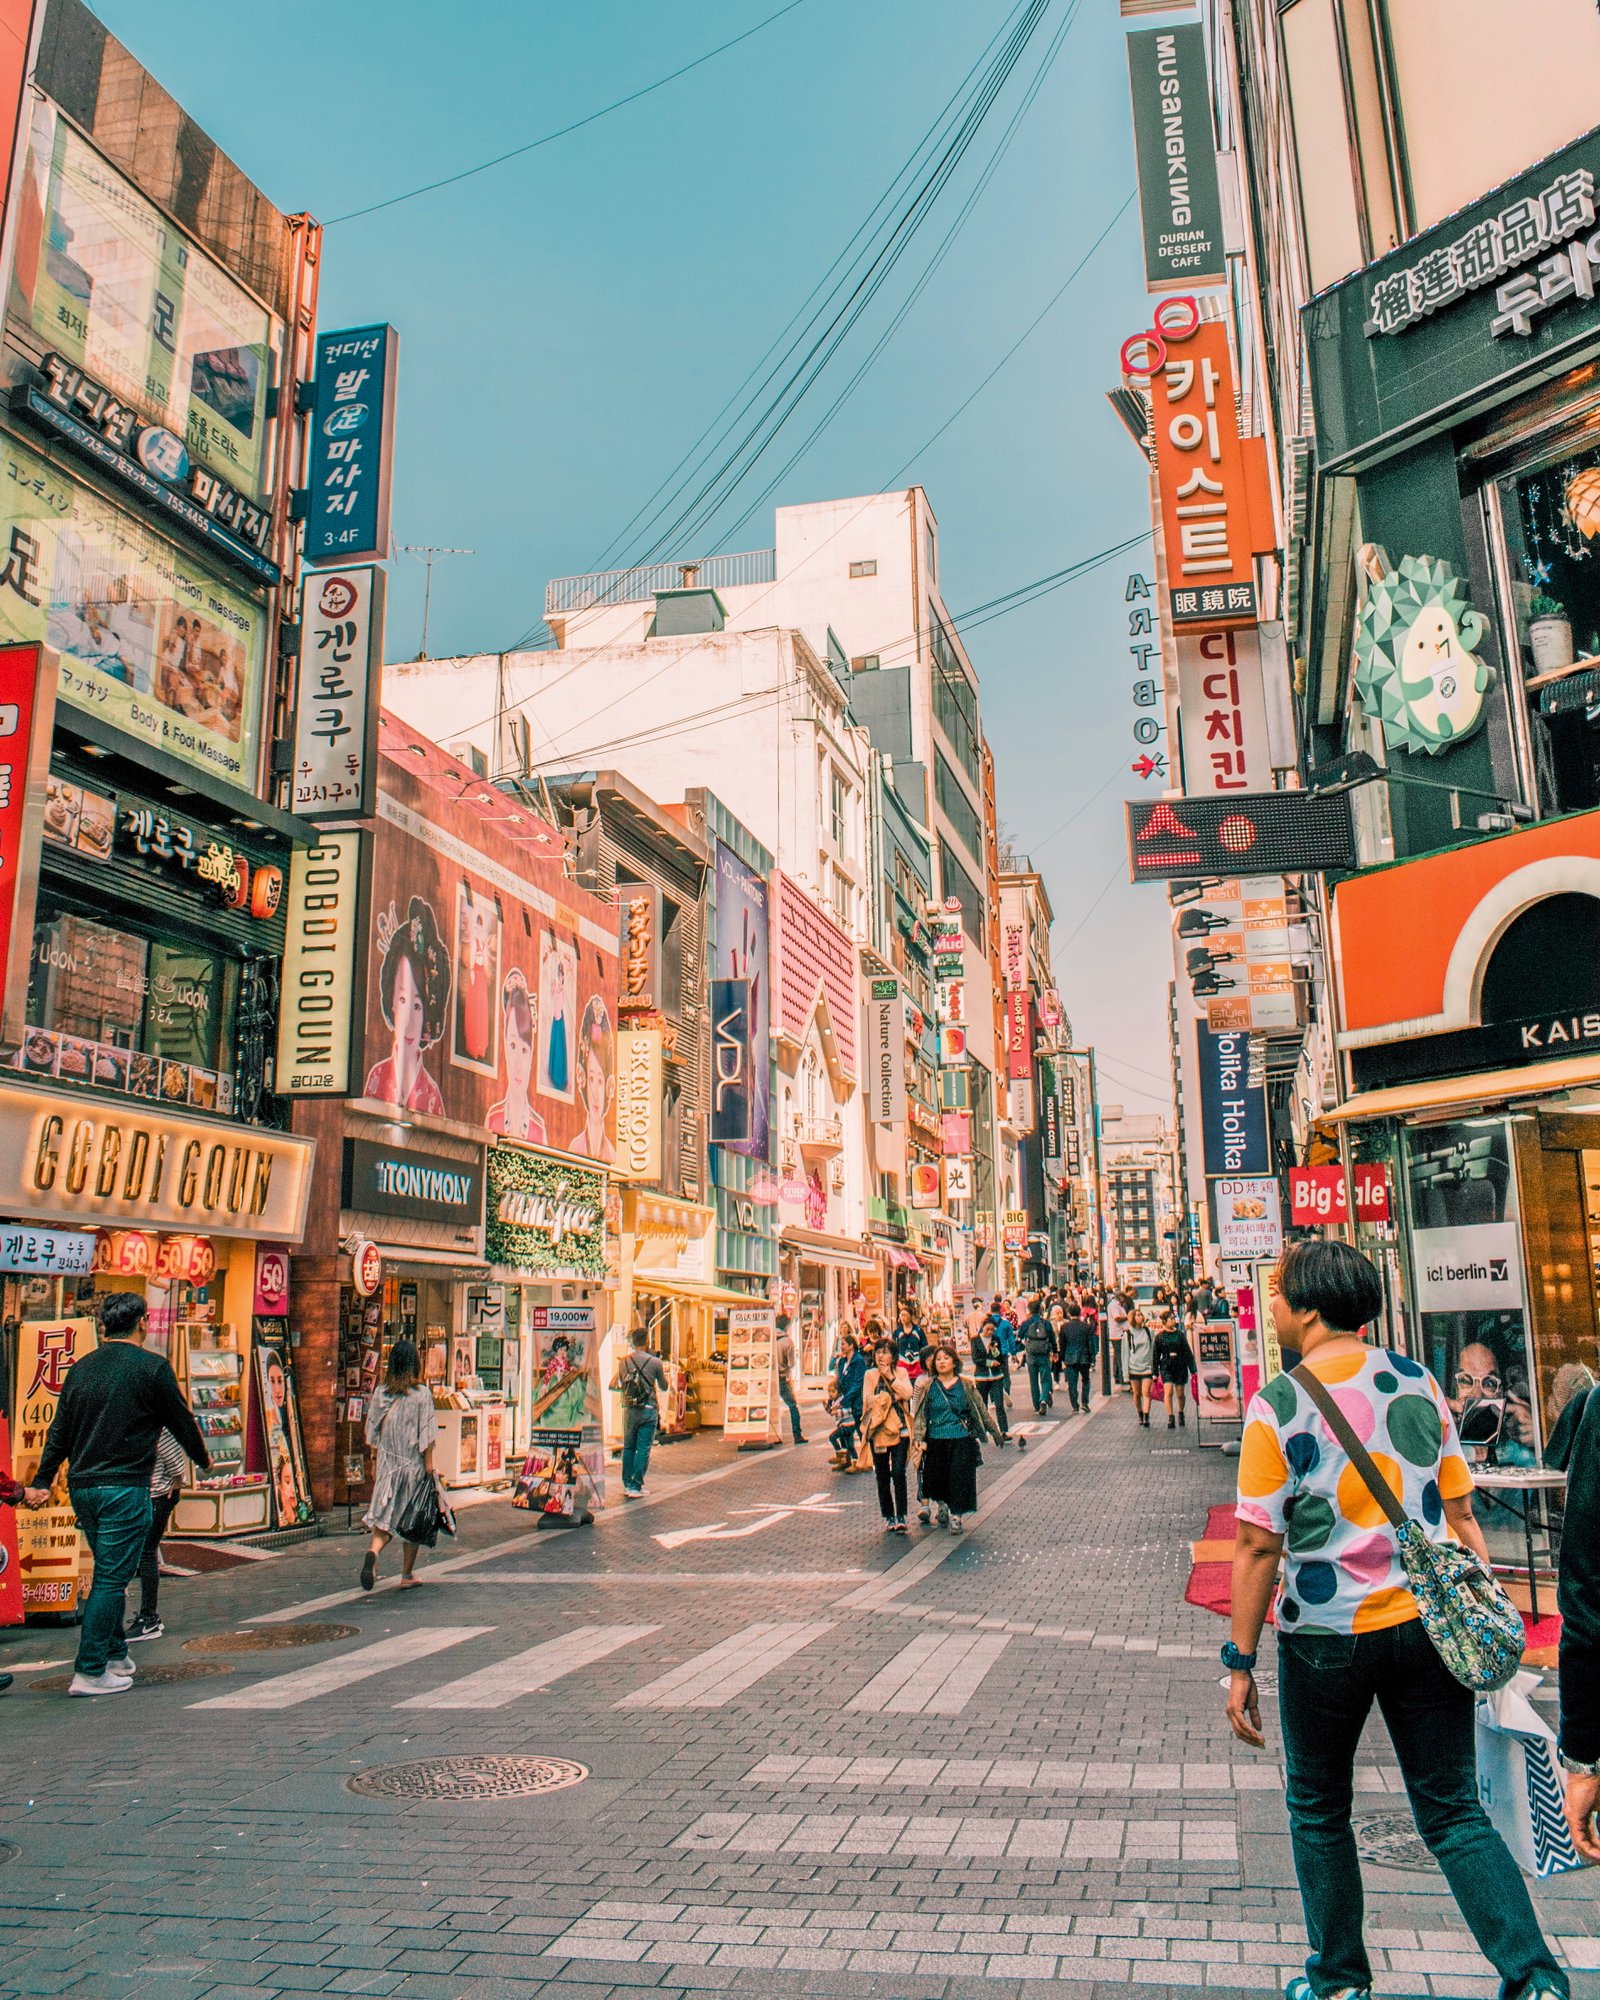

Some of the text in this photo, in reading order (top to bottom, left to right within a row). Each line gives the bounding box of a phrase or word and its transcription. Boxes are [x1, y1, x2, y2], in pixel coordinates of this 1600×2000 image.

[1158, 241, 1211, 257] DESSERT
[1160, 230, 1204, 245] DURIAN
[1171, 255, 1201, 268] CAFE
[325, 337, 379, 364] 컨디션
[47, 355, 137, 448] 컨디션
[192, 469, 272, 549] 마사지
[1165, 357, 1233, 575] 카이스트
[167, 491, 209, 531] 755-4455
[208, 597, 250, 632] massage
[1175, 587, 1252, 614] 眼鏡院
[311, 621, 357, 748] 겐로쿠
[1199, 630, 1248, 790] 디디치킨
[131, 703, 242, 773] Body & Foot Massage
[296, 782, 361, 803] 꼬치구이
[127, 809, 195, 869] 겐로쿠
[301, 843, 342, 954] GOBDI
[934, 938, 964, 951] Mud
[295, 969, 335, 1065] GOUN
[1212, 1007, 1246, 1020] style
[1213, 1016, 1247, 1028] mall
[716, 1008, 742, 1113] VDL
[880, 1003, 892, 1116] Nature Collection
[1018, 1065, 1029, 1077] 3F
[291, 1074, 334, 1089] 곱디고운
[630, 1038, 650, 1173] SKINFOOD
[1046, 1096, 1056, 1156] HOLLYS COFFEE
[1222, 1098, 1246, 1170] Holika
[34, 1114, 274, 1217] GOBDI GOUN
[948, 1168, 967, 1190] 光
[1221, 1181, 1244, 1195] DD
[1295, 1176, 1385, 1215] Big Sale
[735, 1199, 758, 1230] VDL
[1006, 1212, 1024, 1223] BIG
[1006, 1227, 1025, 1239] MART
[6, 1234, 56, 1268] 겐로쿠
[261, 1263, 283, 1293] 50
[1427, 1260, 1487, 1282] ic! berlin
[27, 1326, 79, 1399] 足
[22, 1401, 53, 1426] (40
[22, 1582, 73, 1602] 5-4455 3F
